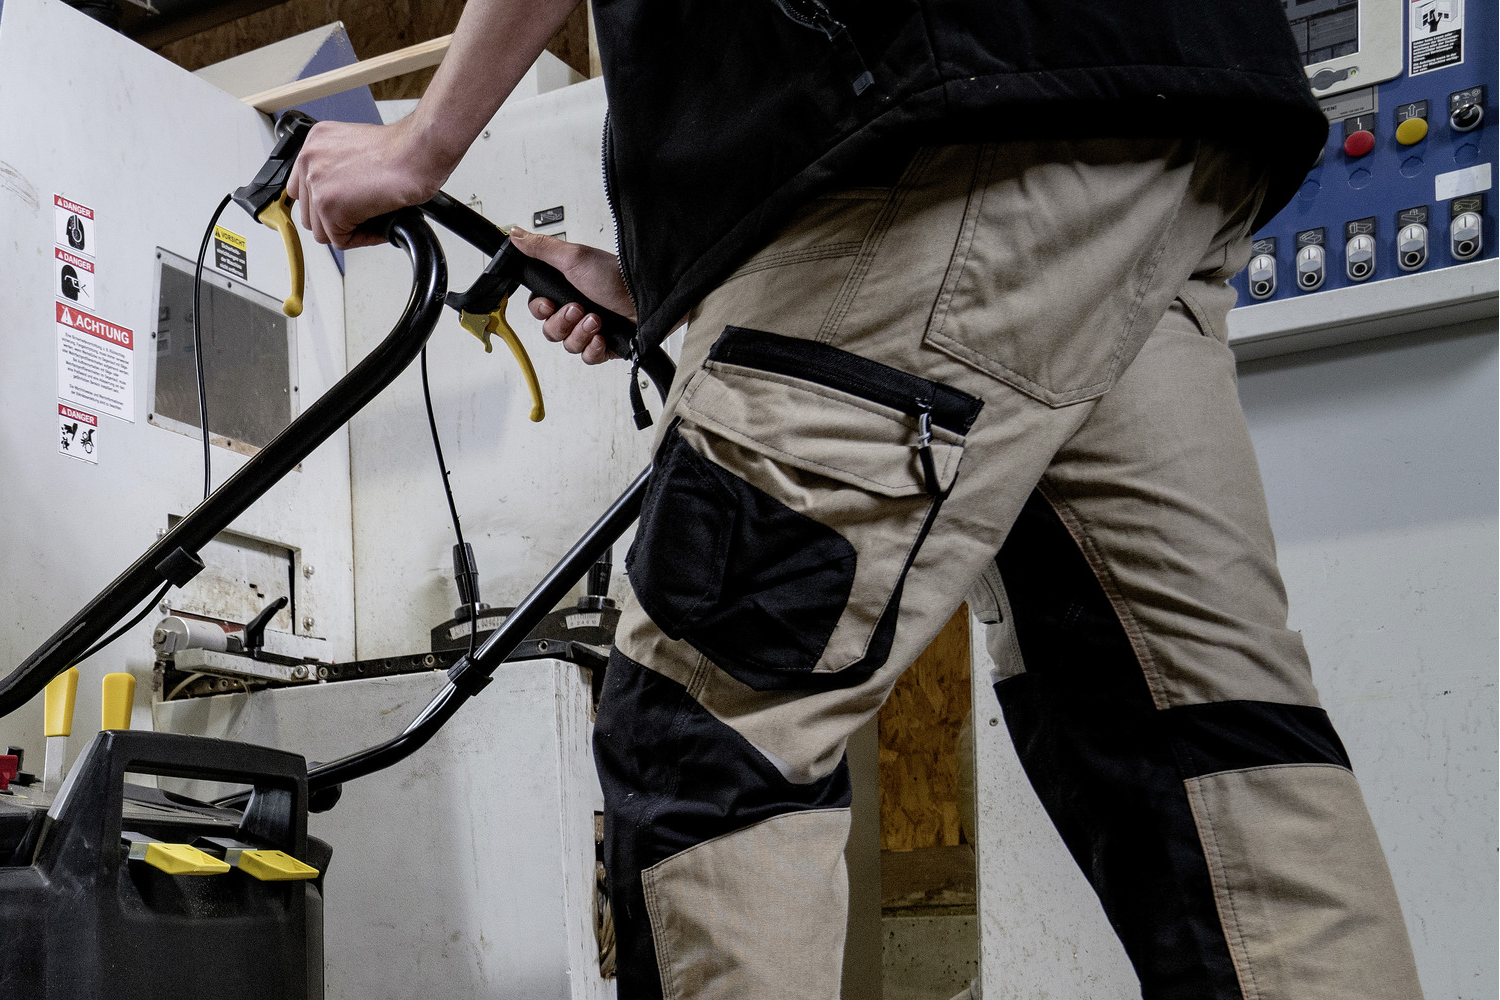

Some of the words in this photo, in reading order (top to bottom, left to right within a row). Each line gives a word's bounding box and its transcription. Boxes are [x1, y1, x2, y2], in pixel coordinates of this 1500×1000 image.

[63, 200, 92, 218] DANGER
[63, 252, 92, 271] DANGER
[76, 314, 130, 345] ACHTUNG
[66, 408, 96, 425] DANGER
